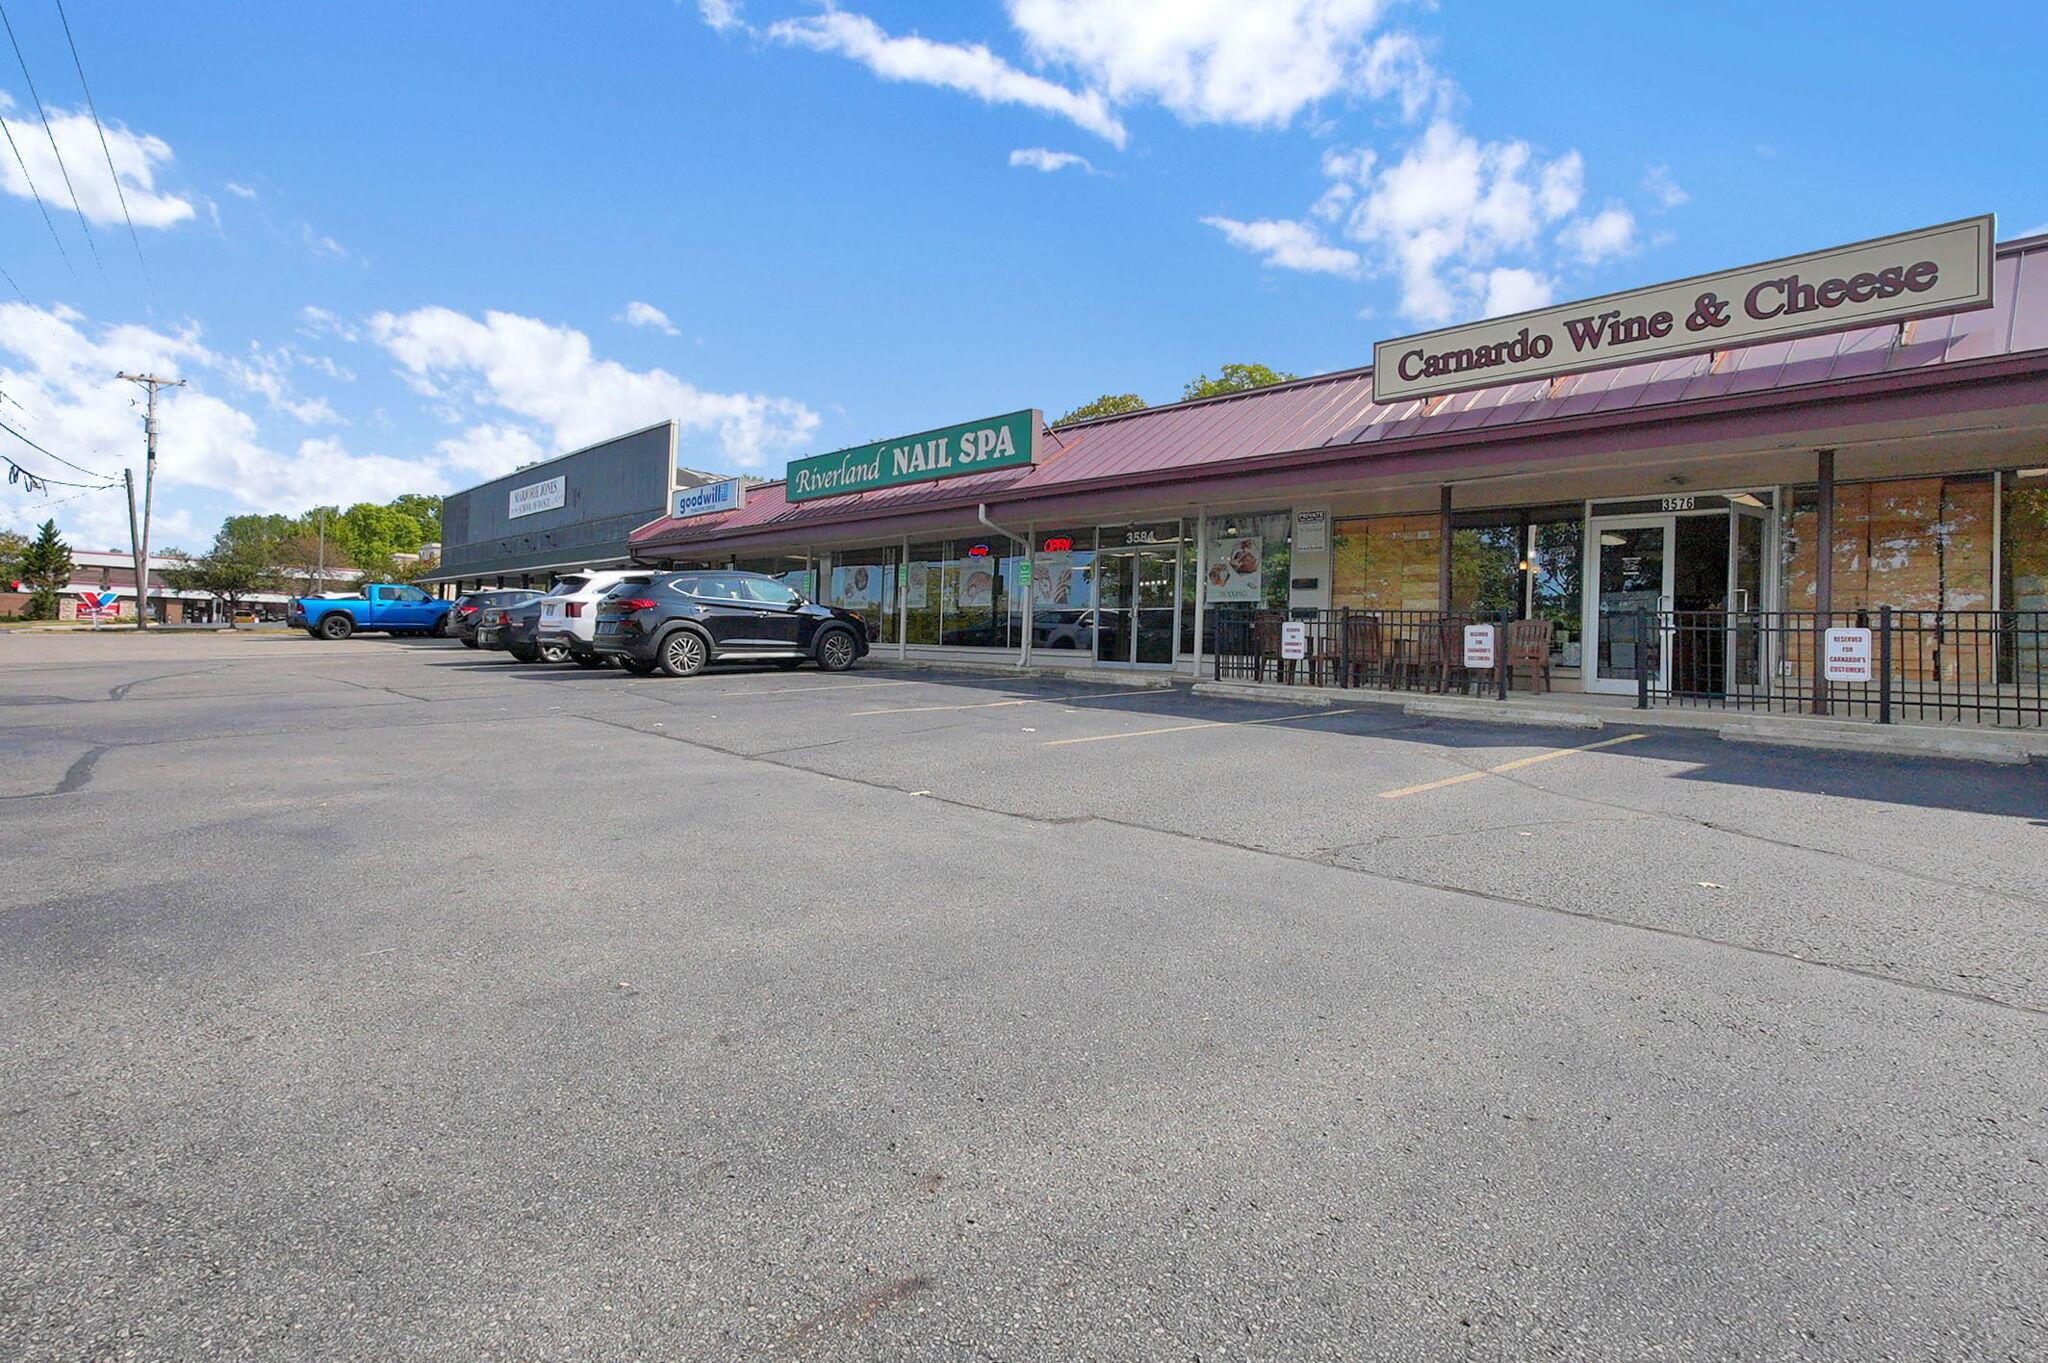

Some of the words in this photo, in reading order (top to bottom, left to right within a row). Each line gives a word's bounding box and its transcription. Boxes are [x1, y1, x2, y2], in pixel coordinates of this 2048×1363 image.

[1397, 329, 1553, 382] Carnardo
[1563, 309, 1674, 353] Wine
[1685, 293, 1731, 332] &
[1743, 259, 1939, 321] Cheese
[795, 447, 881, 494] Riverland
[892, 437, 952, 476] NAIL
[957, 425, 1016, 463] SPA
[680, 484, 721, 514] goodwill
[1663, 497, 1693, 510] 3576
[1044, 538, 1072, 553] OPEN
[1126, 530, 1154, 545] 3584
